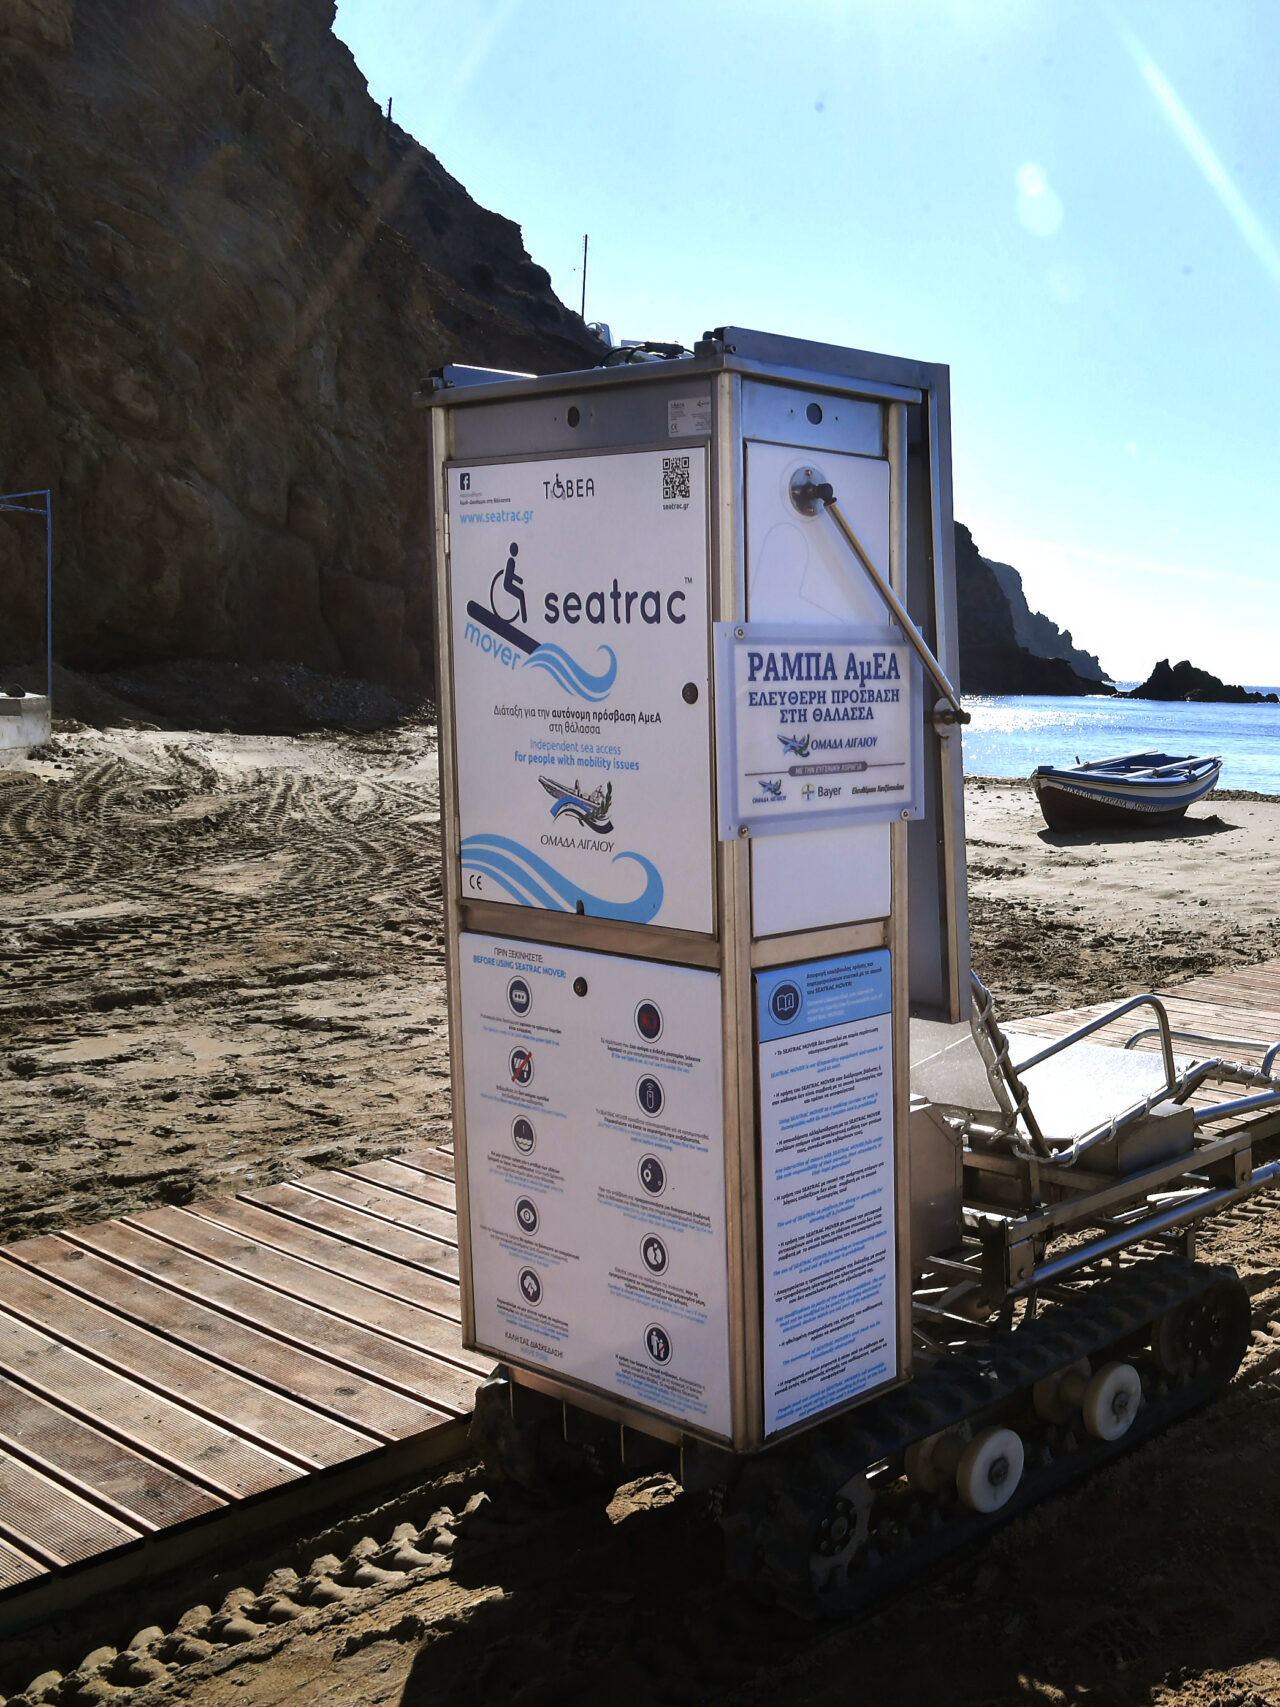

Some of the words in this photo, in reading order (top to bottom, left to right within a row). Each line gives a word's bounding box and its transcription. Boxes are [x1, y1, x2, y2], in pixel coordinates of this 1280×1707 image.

[460, 510, 534, 524] www.seatrac.gr
[544, 578, 686, 624] seatrac
[464, 622, 521, 670] mover
[747, 652, 838, 681] ΡΑΜΠΑ
[843, 652, 900, 687] ΑμΕΑ
[748, 690, 827, 706] ΕΛΕΥΘΕΡΗ
[831, 689, 899, 704] ΠΡΟΣΒΑΣΗ
[493, 705, 523, 720] Διάταξη
[525, 708, 536, 719] για
[538, 709, 550, 719] την
[552, 706, 590, 721] αυτόνομη
[593, 709, 635, 724] πρόσβαση
[780, 709, 807, 723] ΣΤΗ
[813, 707, 874, 722] ΘΑΛΑΣΣΑ
[549, 724, 563, 735] στη
[565, 722, 600, 734] θάλασσα
[530, 739, 578, 752] Independent
[580, 744, 593, 753] sea
[596, 746, 622, 755] access
[811, 738, 843, 750] ΟΜΑΔΑ
[845, 736, 878, 748] ΑΙΓΑΙΟΥ
[515, 751, 527, 762] for
[528, 754, 555, 766] people
[558, 754, 575, 766] with
[577, 756, 611, 771] mobility
[613, 758, 639, 771] issues
[818, 786, 841, 798] Bayer
[540, 834, 576, 848] ΟΜΑΔΑ
[577, 839, 615, 853] ΑΙΓΑΙΟΥ
[473, 954, 495, 966] BEFORE
[496, 960, 513, 969] USING
[515, 961, 541, 974] SEATRAC
